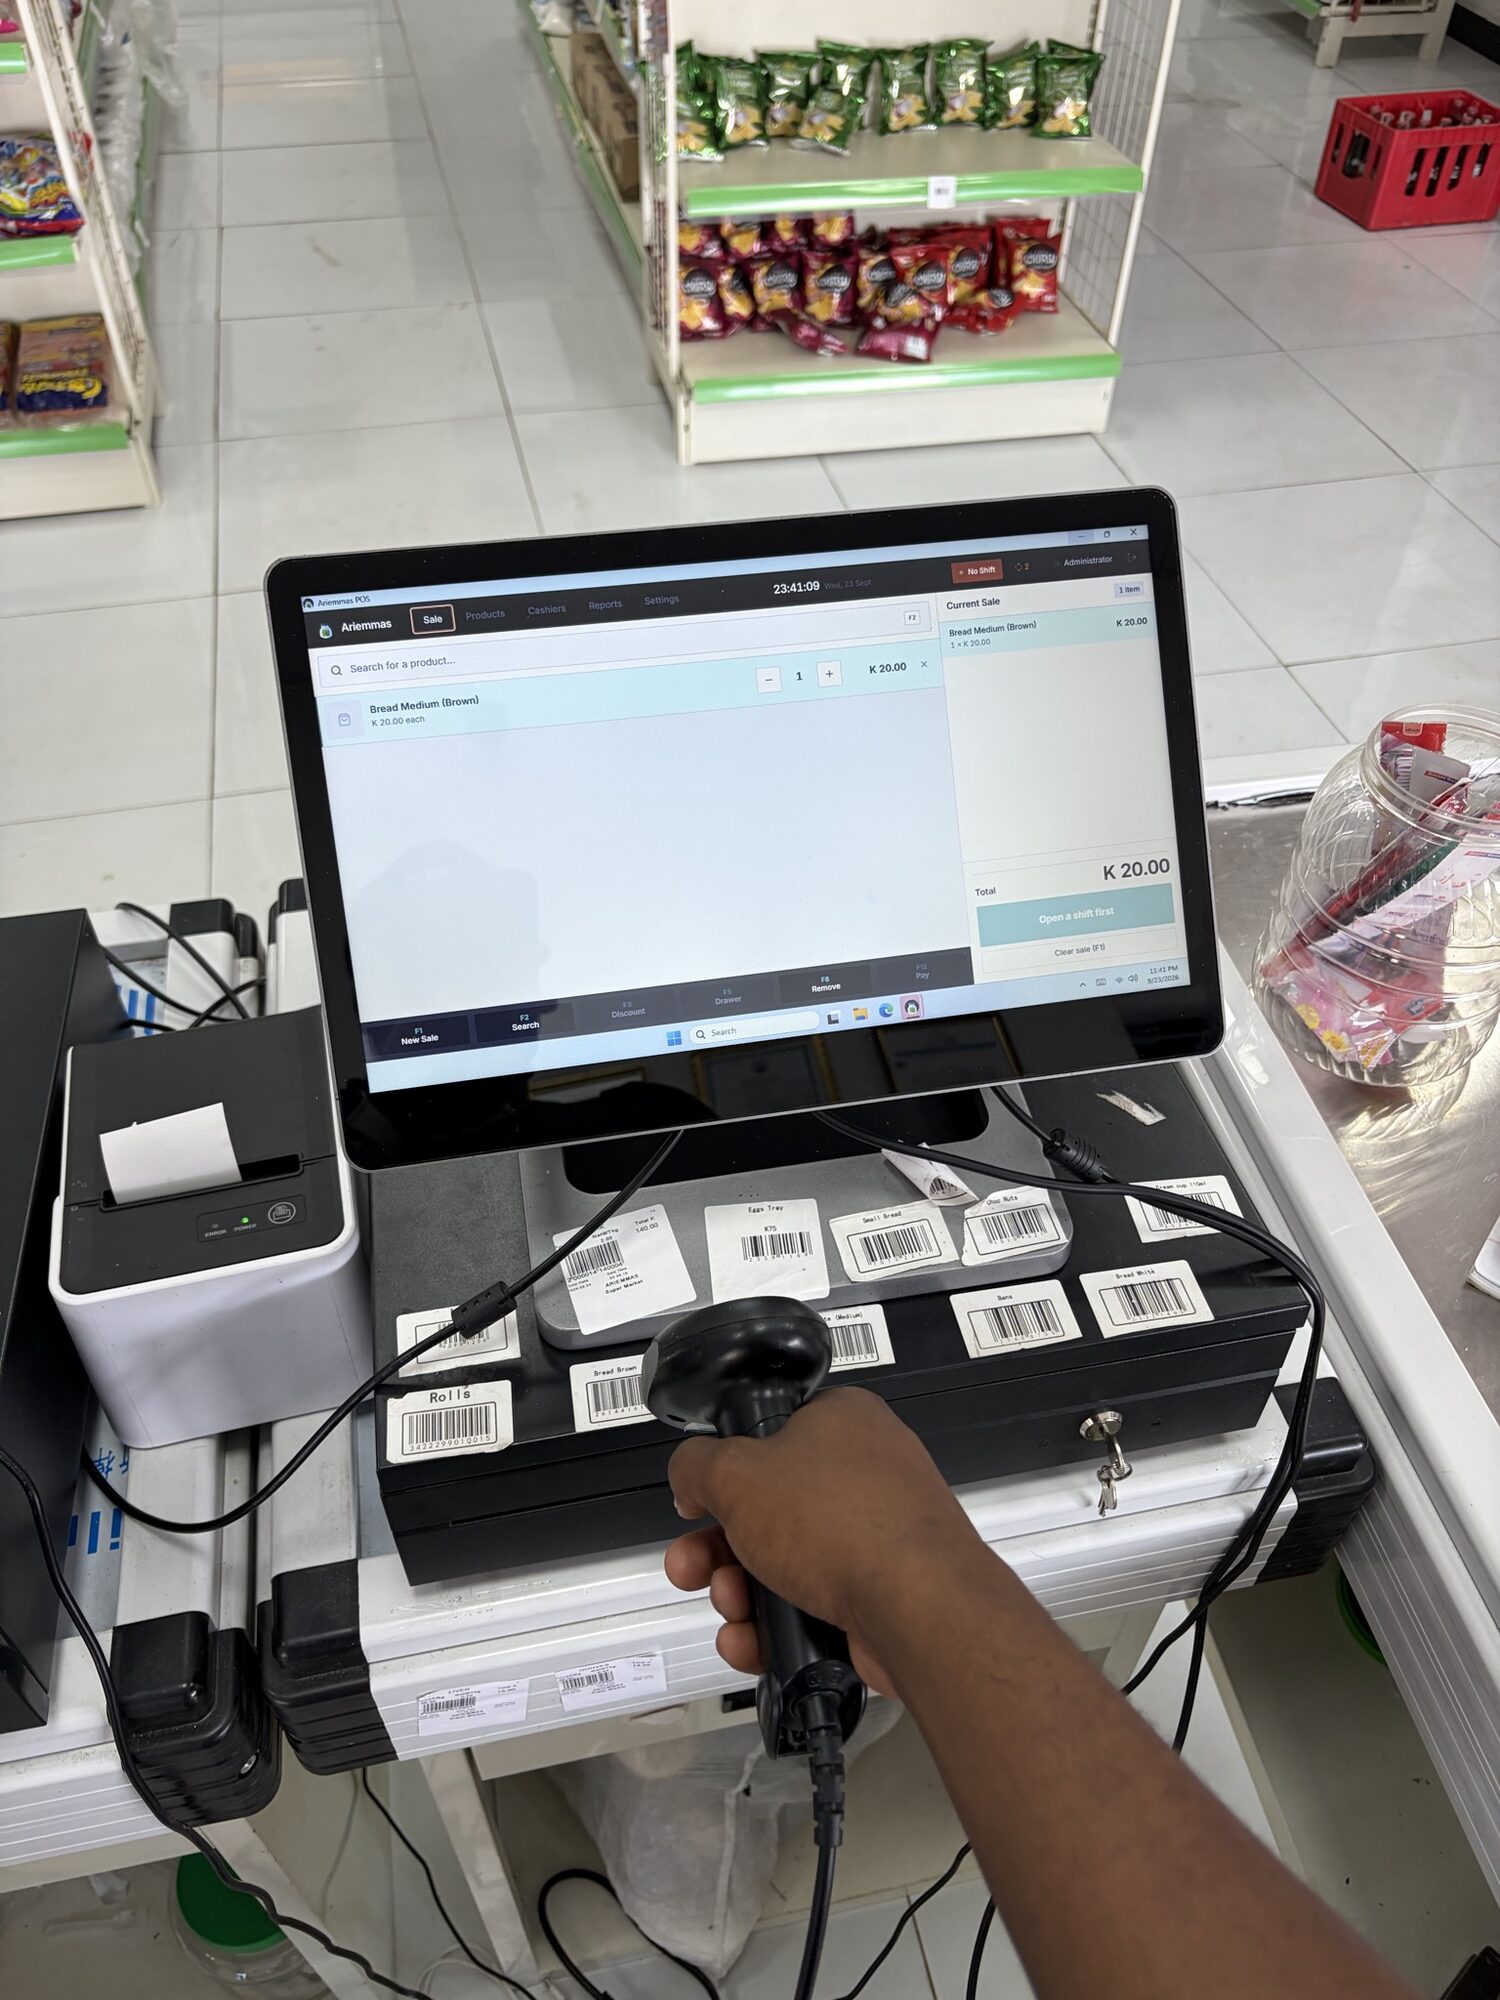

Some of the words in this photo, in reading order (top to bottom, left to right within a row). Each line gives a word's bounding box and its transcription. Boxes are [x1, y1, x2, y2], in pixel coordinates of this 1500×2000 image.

[1063, 555, 1113, 567] Administrator
[967, 567, 978, 576] No
[979, 565, 996, 575] Shift
[773, 580, 820, 595] 23:41:09
[844, 580, 854, 588] 23
[1118, 586, 1123, 594] 1
[1124, 584, 1141, 594] item
[318, 598, 353, 607] Ariemmas
[355, 595, 371, 604] POS
[588, 600, 623, 611] Reports
[644, 595, 680, 606] Settings
[946, 598, 980, 610] Current
[981, 597, 1001, 608] Sale
[465, 608, 505, 621] Products
[527, 603, 567, 616] Cashiers
[423, 614, 443, 625] Sale
[1116, 619, 1123, 628] K
[1123, 617, 1148, 627] 20.00
[341, 620, 392, 633] Ariemmas
[949, 626, 972, 637] Bread
[973, 623, 1005, 635] Medium
[1006, 620, 1037, 633] (Brown)
[950, 641, 956, 649] 1
[963, 640, 969, 648] K
[970, 638, 991, 647] 20.00
[350, 662, 383, 674] Search
[386, 660, 400, 671] for
[401, 661, 409, 669] a
[869, 664, 877, 675] K
[879, 662, 907, 674] 20.00
[796, 671, 803, 681] 1
[369, 703, 399, 715] Bread
[400, 699, 440, 712] Medium
[441, 694, 480, 709] (Brown)
[371, 719, 378, 728] K
[379, 716, 404, 727] 20.00
[405, 714, 425, 725] each
[1103, 864, 1117, 881] K
[1119, 857, 1171, 879] 20.00
[974, 886, 997, 898] Total
[1039, 914, 1064, 925] Open
[1065, 913, 1072, 922] a
[1072, 909, 1094, 920] shift
[1094, 906, 1115, 918] first
[1054, 947, 1074, 957] Clear
[1076, 945, 1091, 955] sale
[1092, 943, 1106, 953] (F1)
[1149, 966, 1166, 974] 11:41
[915, 972, 930, 981] Pay
[1147, 974, 1180, 985] 9/23/2026
[811, 984, 841, 993] Remove
[715, 996, 742, 1005] Drawer
[611, 1007, 647, 1018] Discount
[414, 1027, 423, 1035] F1
[512, 1021, 540, 1031] Search
[711, 1026, 737, 1037] Search
[401, 1036, 420, 1046] New
[421, 1033, 439, 1043] Sale
[862, 1214, 881, 1223] Small
[883, 1210, 902, 1219] Bread
[234, 1223, 257, 1232] POWER
[204, 1229, 227, 1238] ERROR
[1115, 1271, 1135, 1279] Bread
[1136, 1268, 1155, 1276] White
[594, 1368, 615, 1376] Bread
[616, 1365, 638, 1373] Brown
[429, 1389, 471, 1404] Rolls
